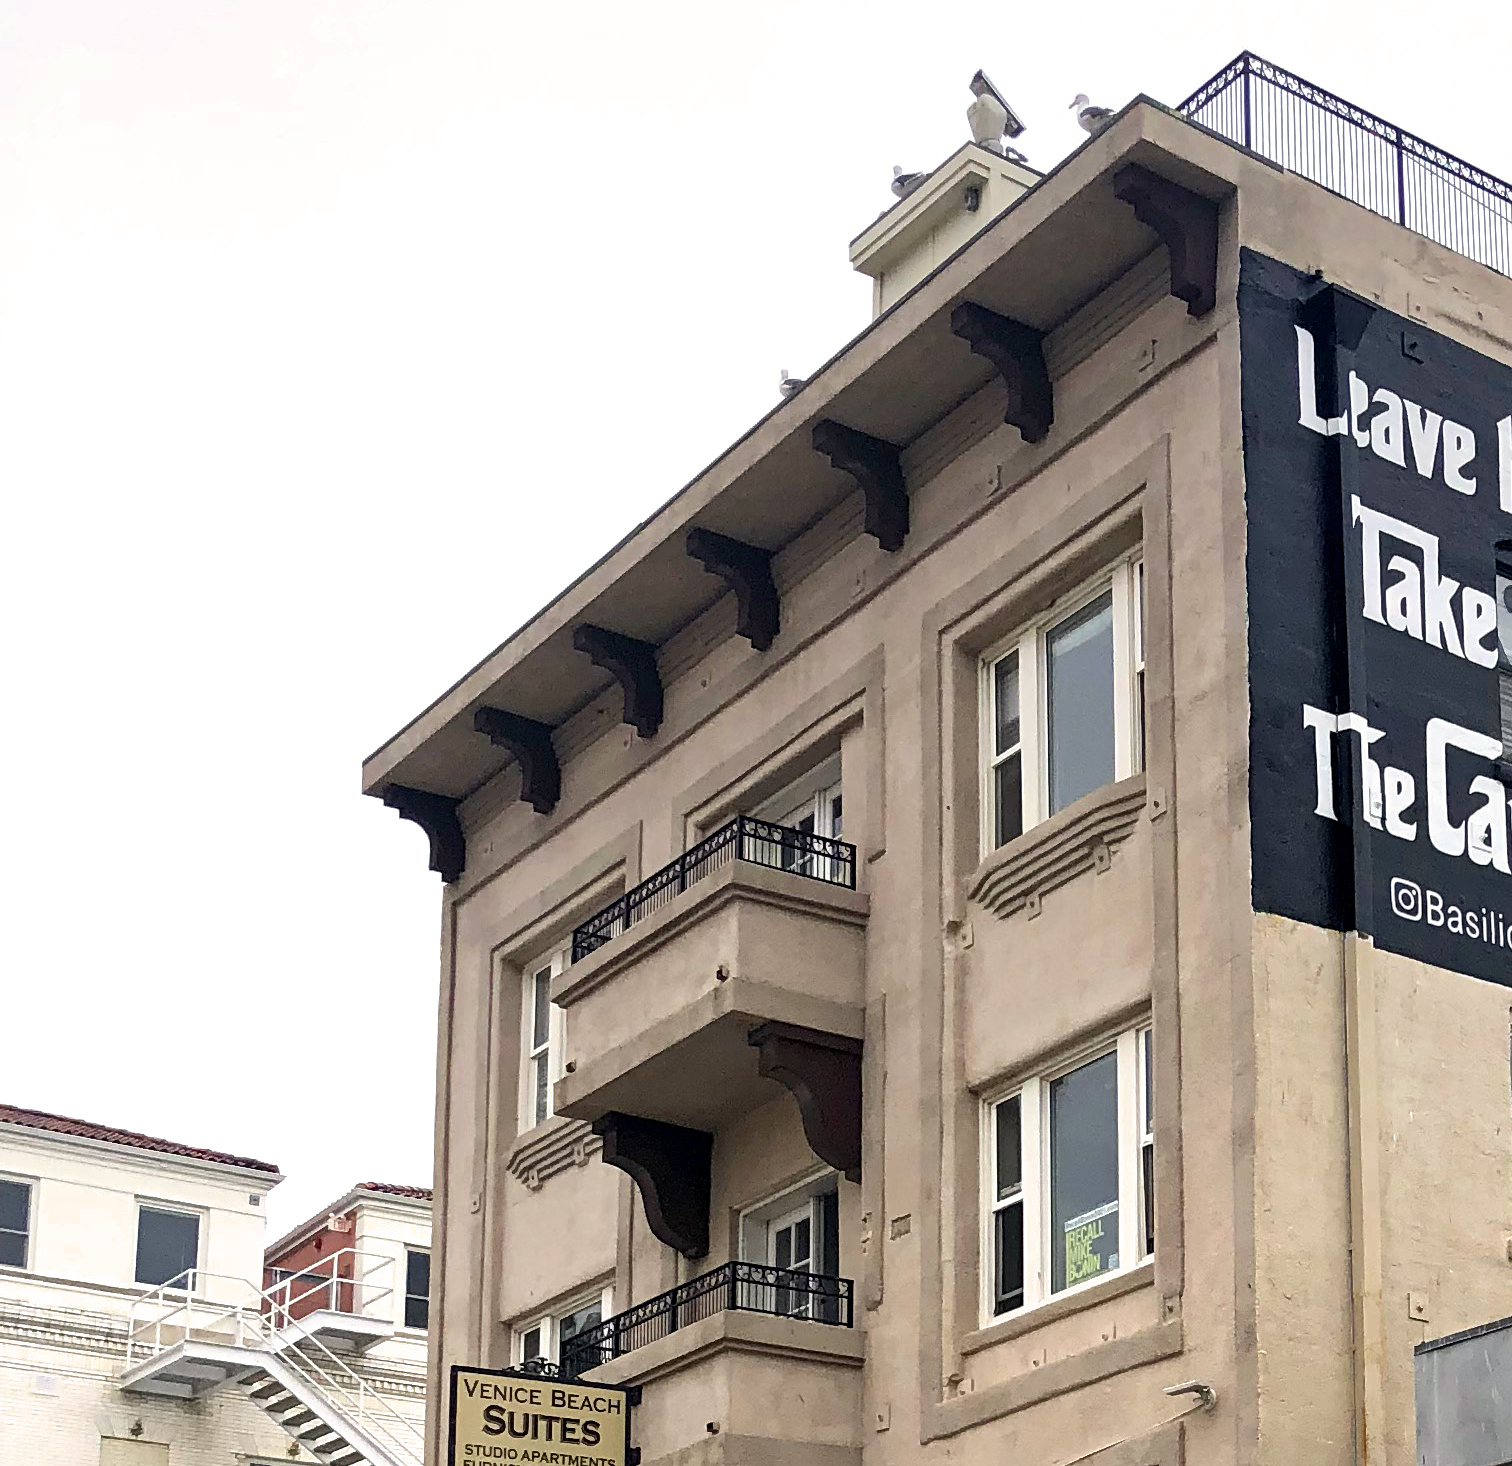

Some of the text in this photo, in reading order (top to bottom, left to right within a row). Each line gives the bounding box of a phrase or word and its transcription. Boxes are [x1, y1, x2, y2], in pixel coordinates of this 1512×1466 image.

[1294, 324, 1476, 495] Leave
[1352, 494, 1498, 669] Take
[1303, 703, 1417, 841] The
[1070, 1220, 1105, 1248] RECALL
[464, 1379, 621, 1414] VENICE BEACH
[482, 1405, 601, 1446] SUITES
[464, 1444, 518, 1459] STUDIO
